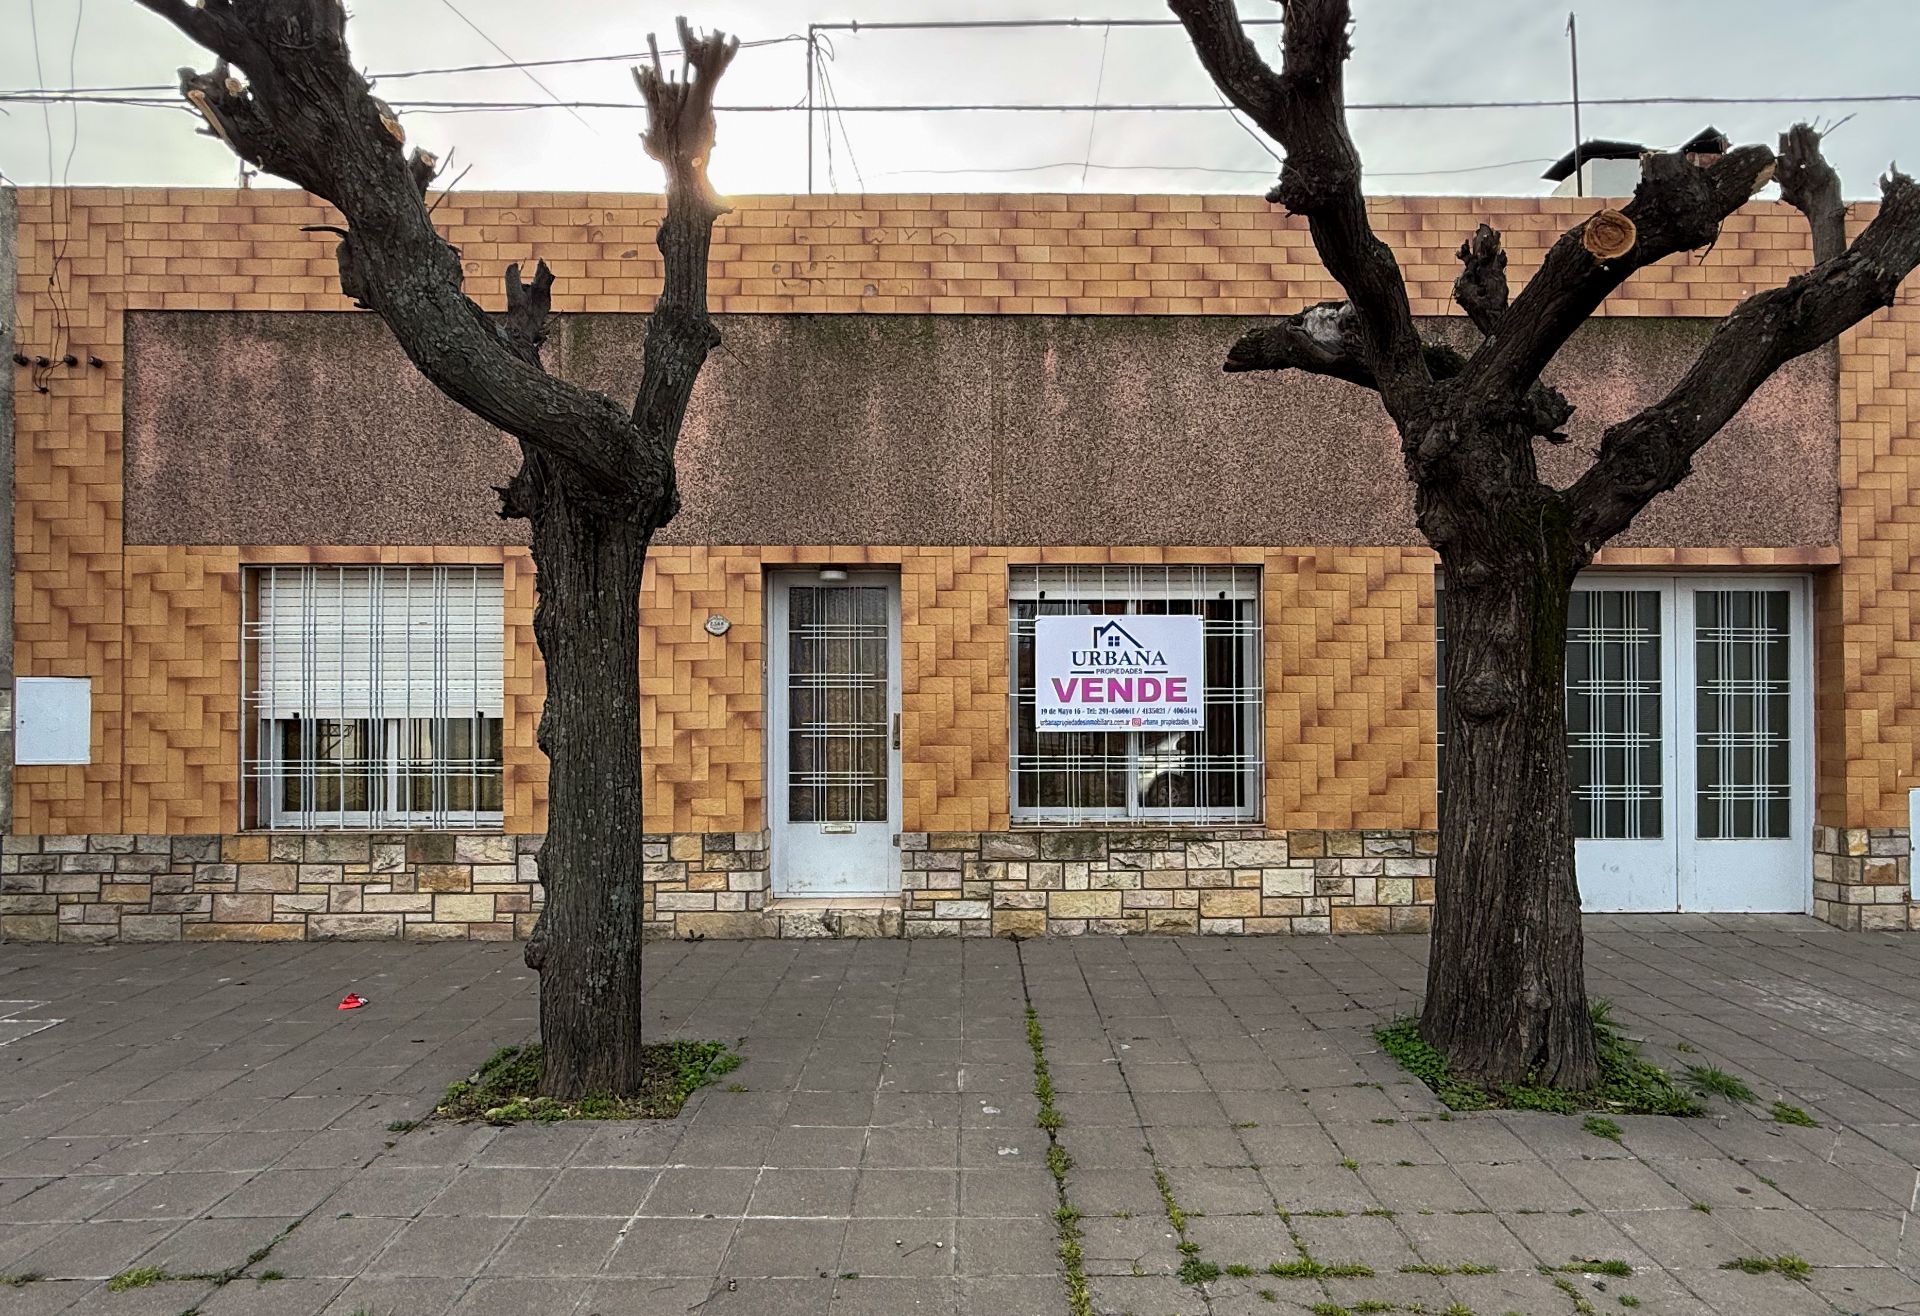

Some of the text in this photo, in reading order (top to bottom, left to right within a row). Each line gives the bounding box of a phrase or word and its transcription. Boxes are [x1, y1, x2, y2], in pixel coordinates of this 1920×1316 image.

[1071, 650, 1168, 667] URBANA
[1051, 677, 1188, 703] VENDE
[1048, 707, 1057, 715] de
[1057, 707, 1073, 716] Mayo
[1086, 707, 1097, 715] Tel:
